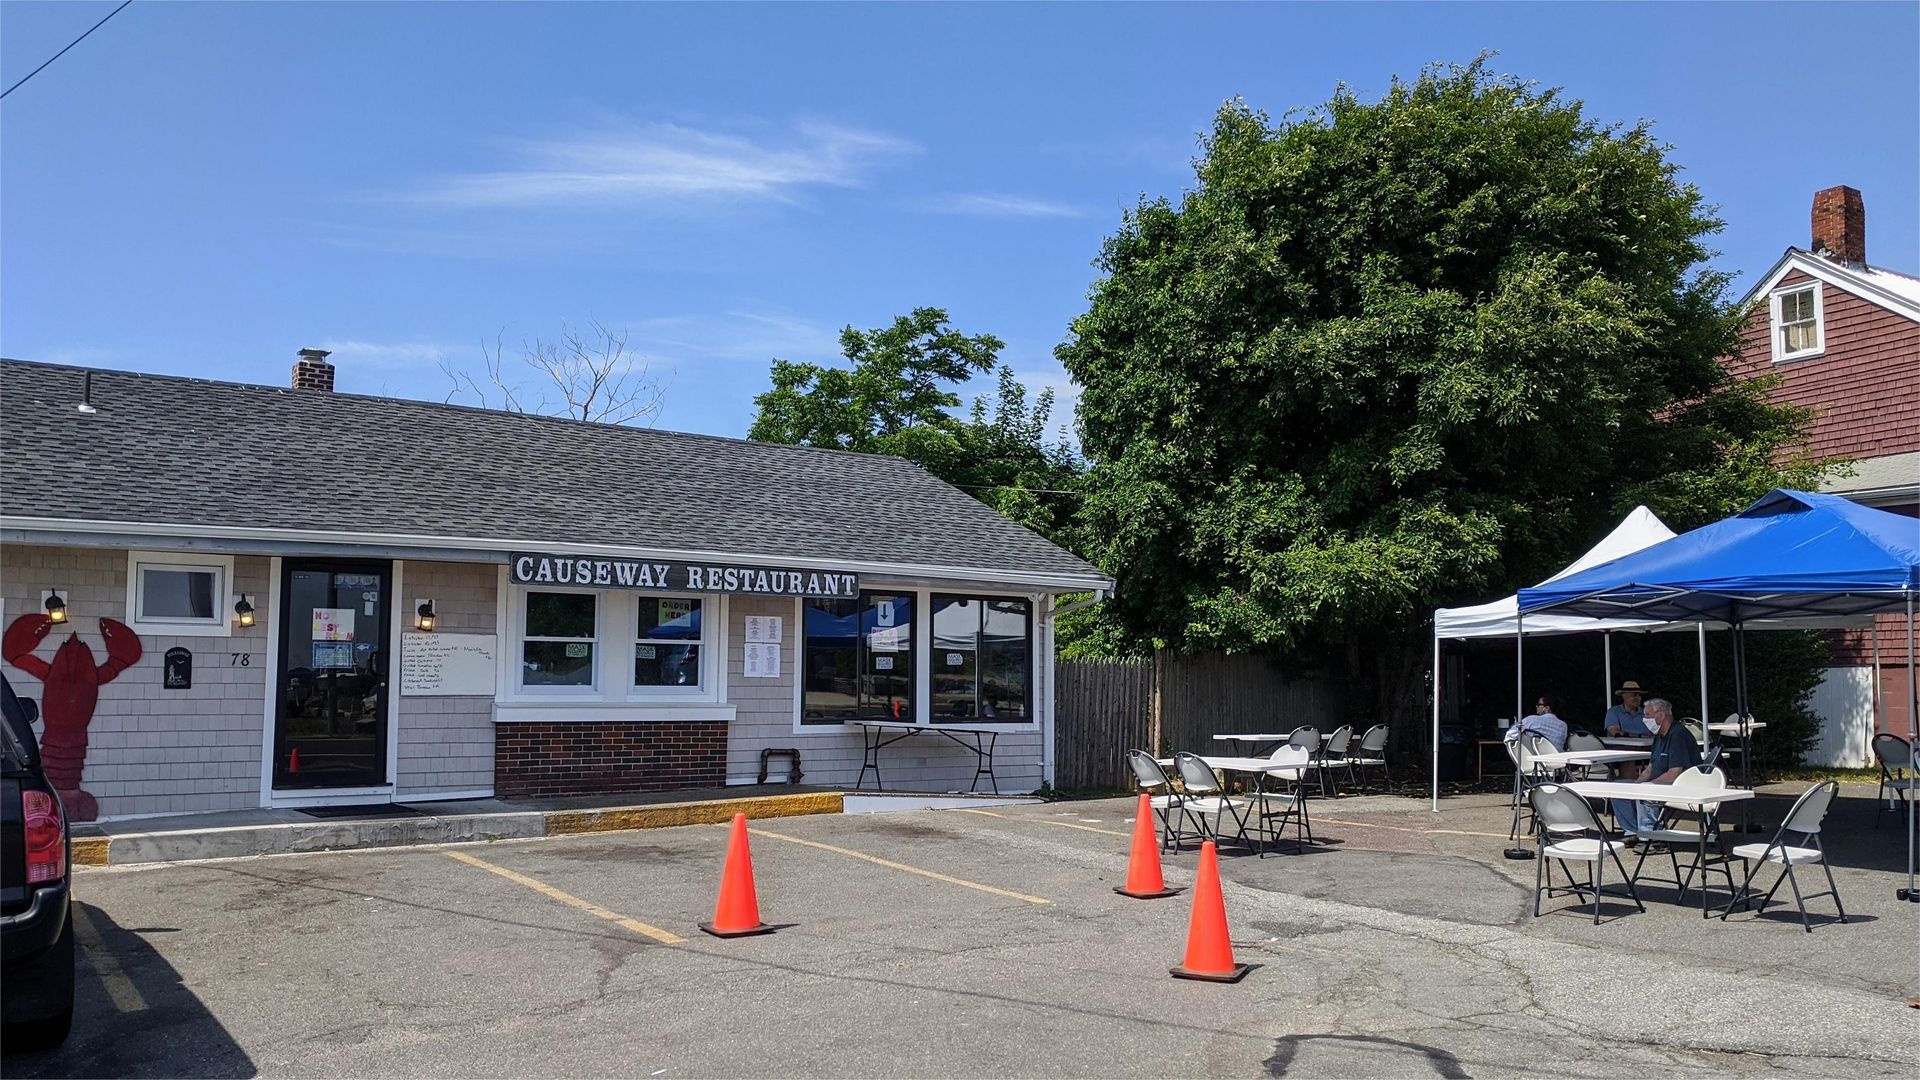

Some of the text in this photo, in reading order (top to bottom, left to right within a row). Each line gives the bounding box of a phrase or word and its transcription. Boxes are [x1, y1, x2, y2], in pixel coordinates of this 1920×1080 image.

[515, 557, 856, 596] CAUSEWAY RESTAURANT
[662, 601, 690, 610] ORDER
[315, 611, 329, 620] NO
[231, 653, 251, 667] 78
